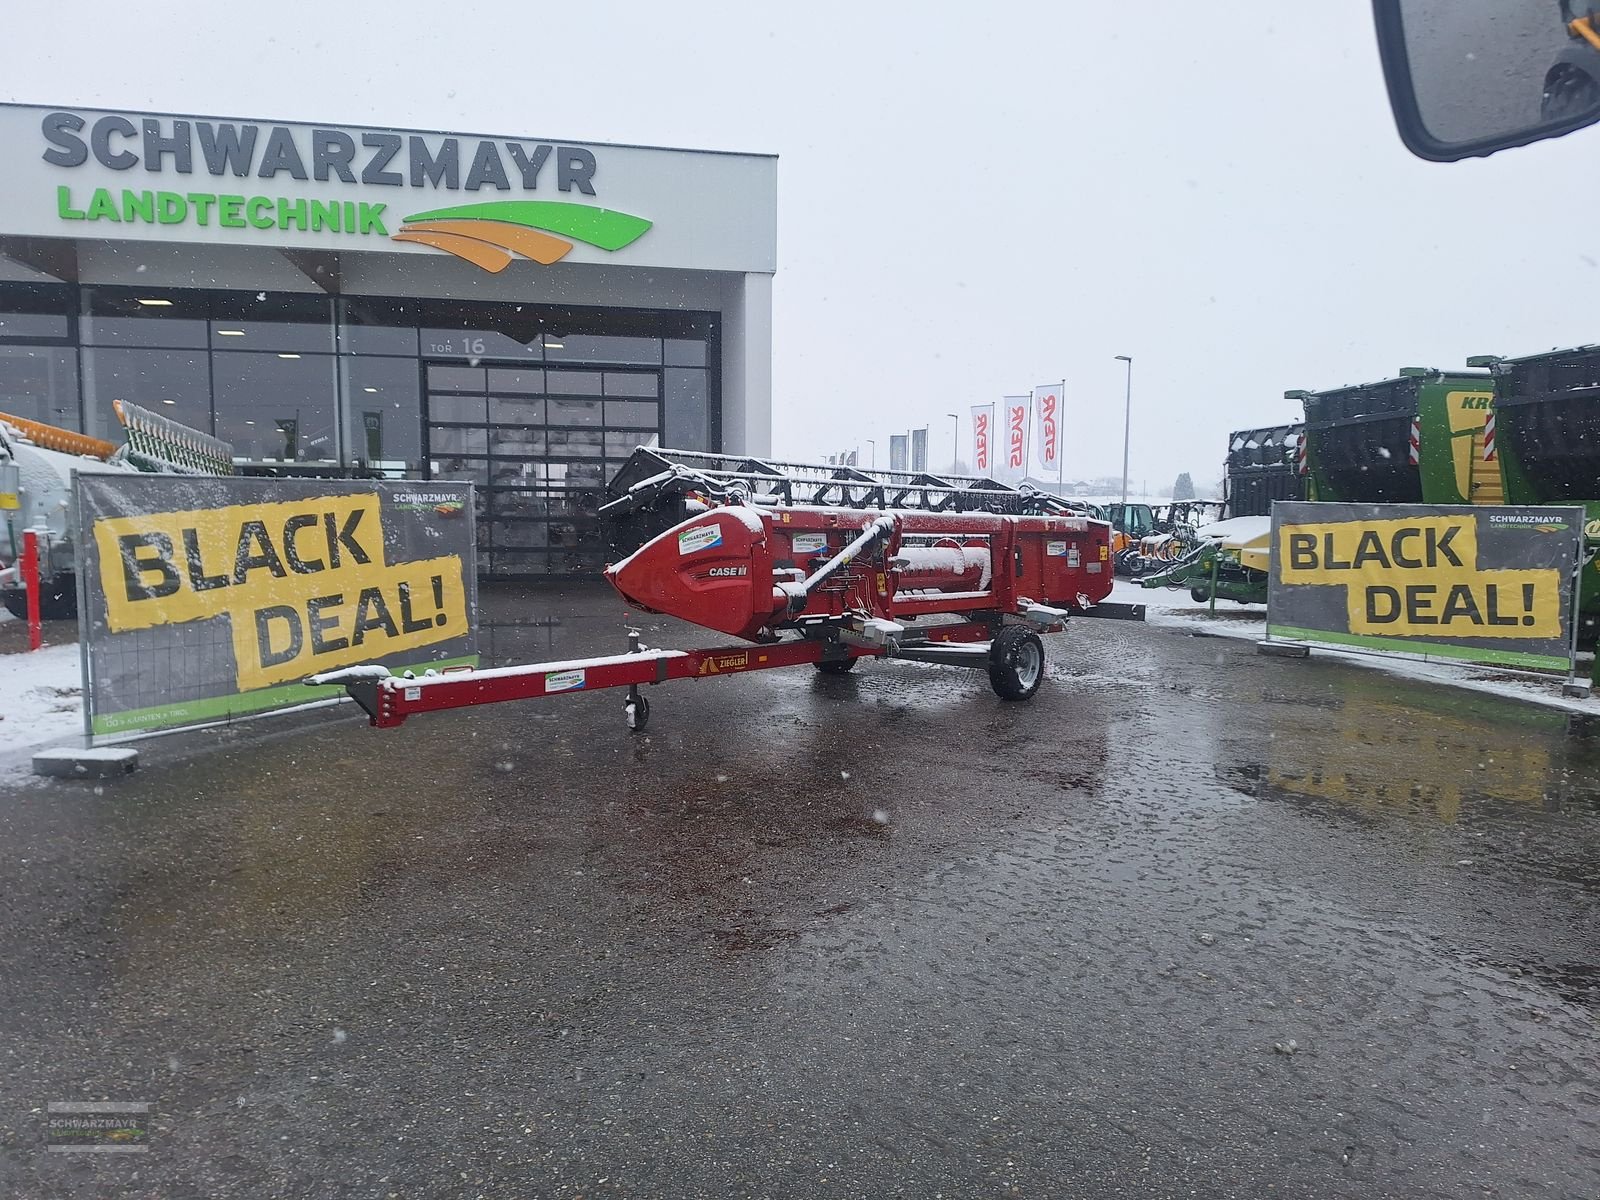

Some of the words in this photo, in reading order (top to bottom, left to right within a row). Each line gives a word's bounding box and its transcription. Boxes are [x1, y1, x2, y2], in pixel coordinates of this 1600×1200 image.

[42, 112, 597, 195] SCHWARZMAYR
[57, 185, 389, 236] LANDTECHNIK
[430, 343, 453, 353] TOR
[462, 337, 486, 355] 16
[393, 493, 457, 503] SCHWARZMAYR
[1490, 515, 1563, 523] SCHWARZMAYR
[118, 508, 372, 601] BLACK
[1291, 526, 1464, 570] BLACK
[709, 567, 737, 576] CASE
[254, 574, 447, 669] DEAL!
[1366, 584, 1535, 627] DEAL!
[720, 657, 745, 668] ZIEGLER
